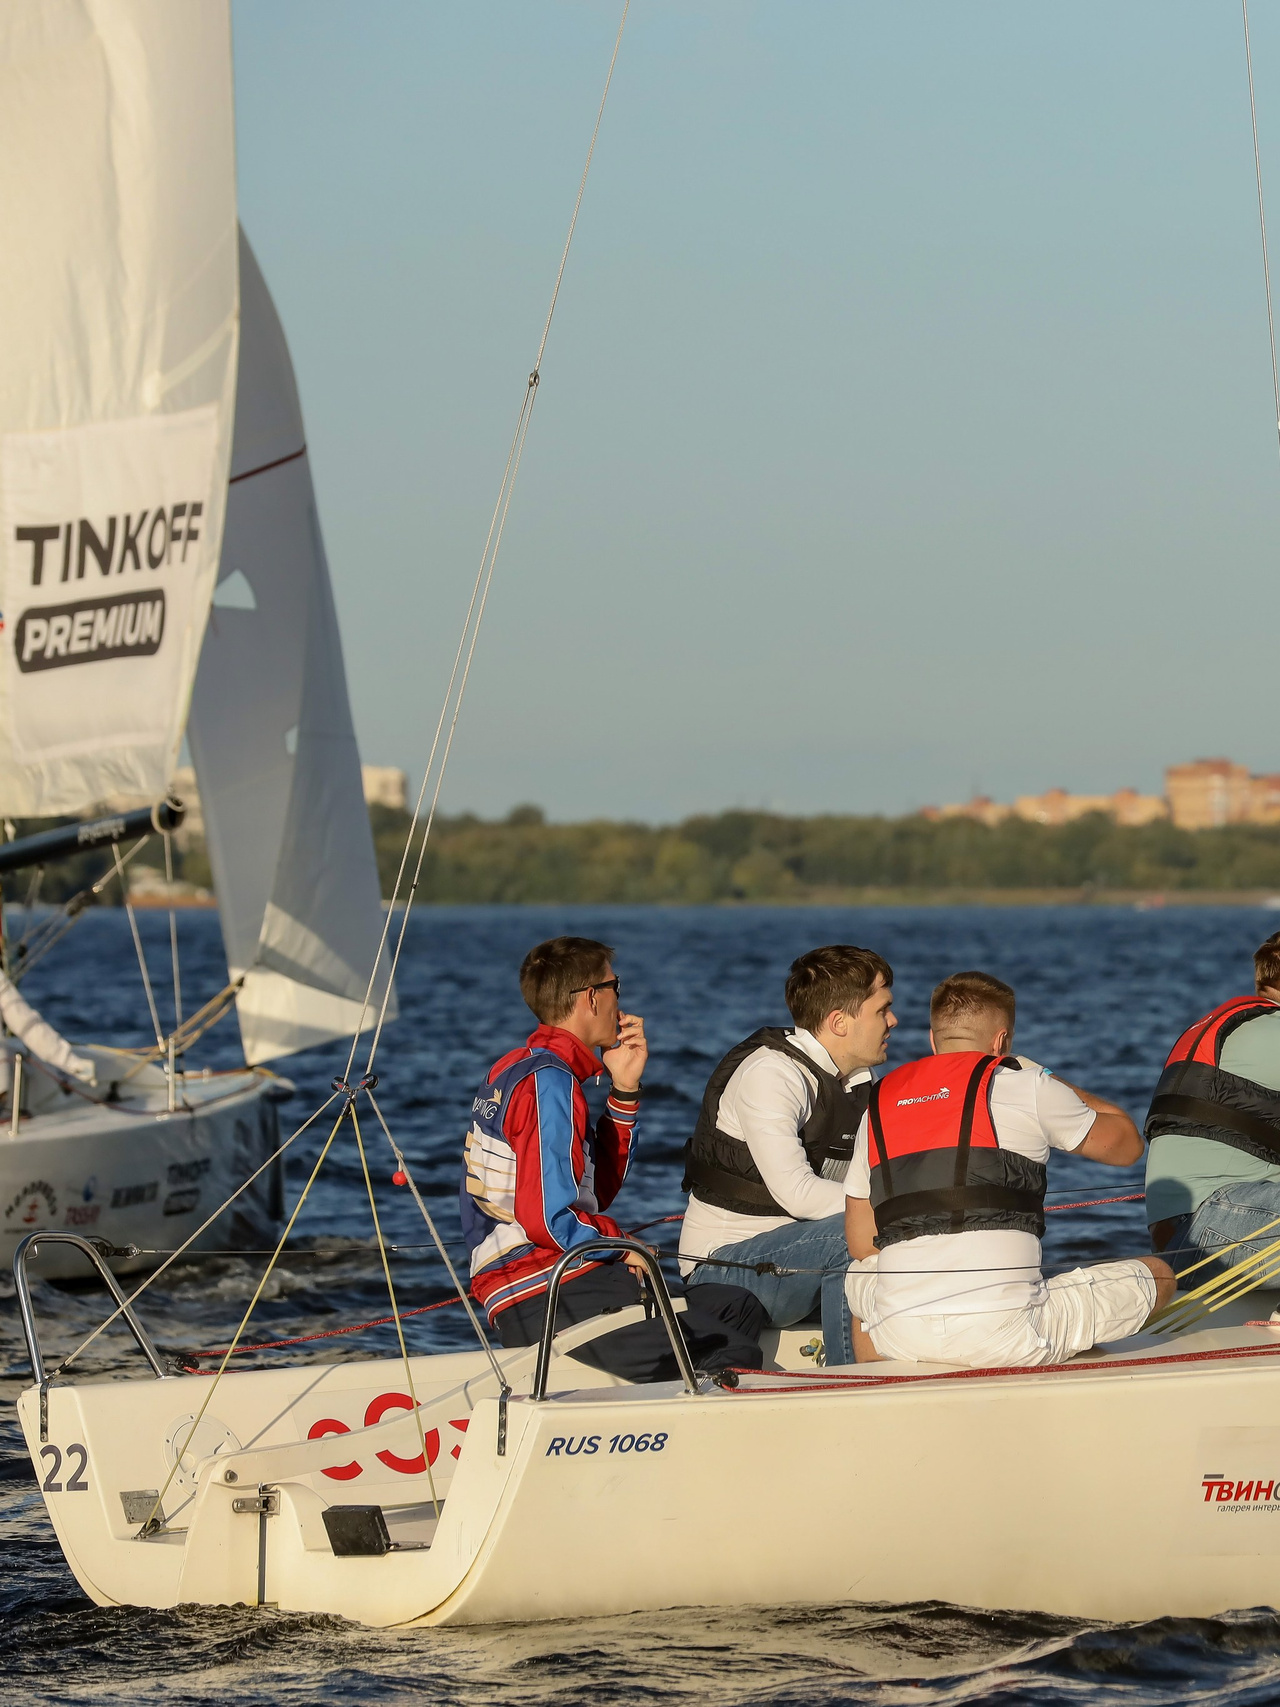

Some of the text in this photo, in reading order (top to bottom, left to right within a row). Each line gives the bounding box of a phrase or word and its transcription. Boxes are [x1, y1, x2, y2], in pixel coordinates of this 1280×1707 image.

[16, 502, 203, 585] TINKOFF
[22, 600, 162, 662] PREMIUM
[897, 1092, 949, 1106] PROYACHTING
[545, 1432, 668, 1456] RUS 1068
[41, 1444, 88, 1491] 22
[1217, 1504, 1250, 1513] галерея
